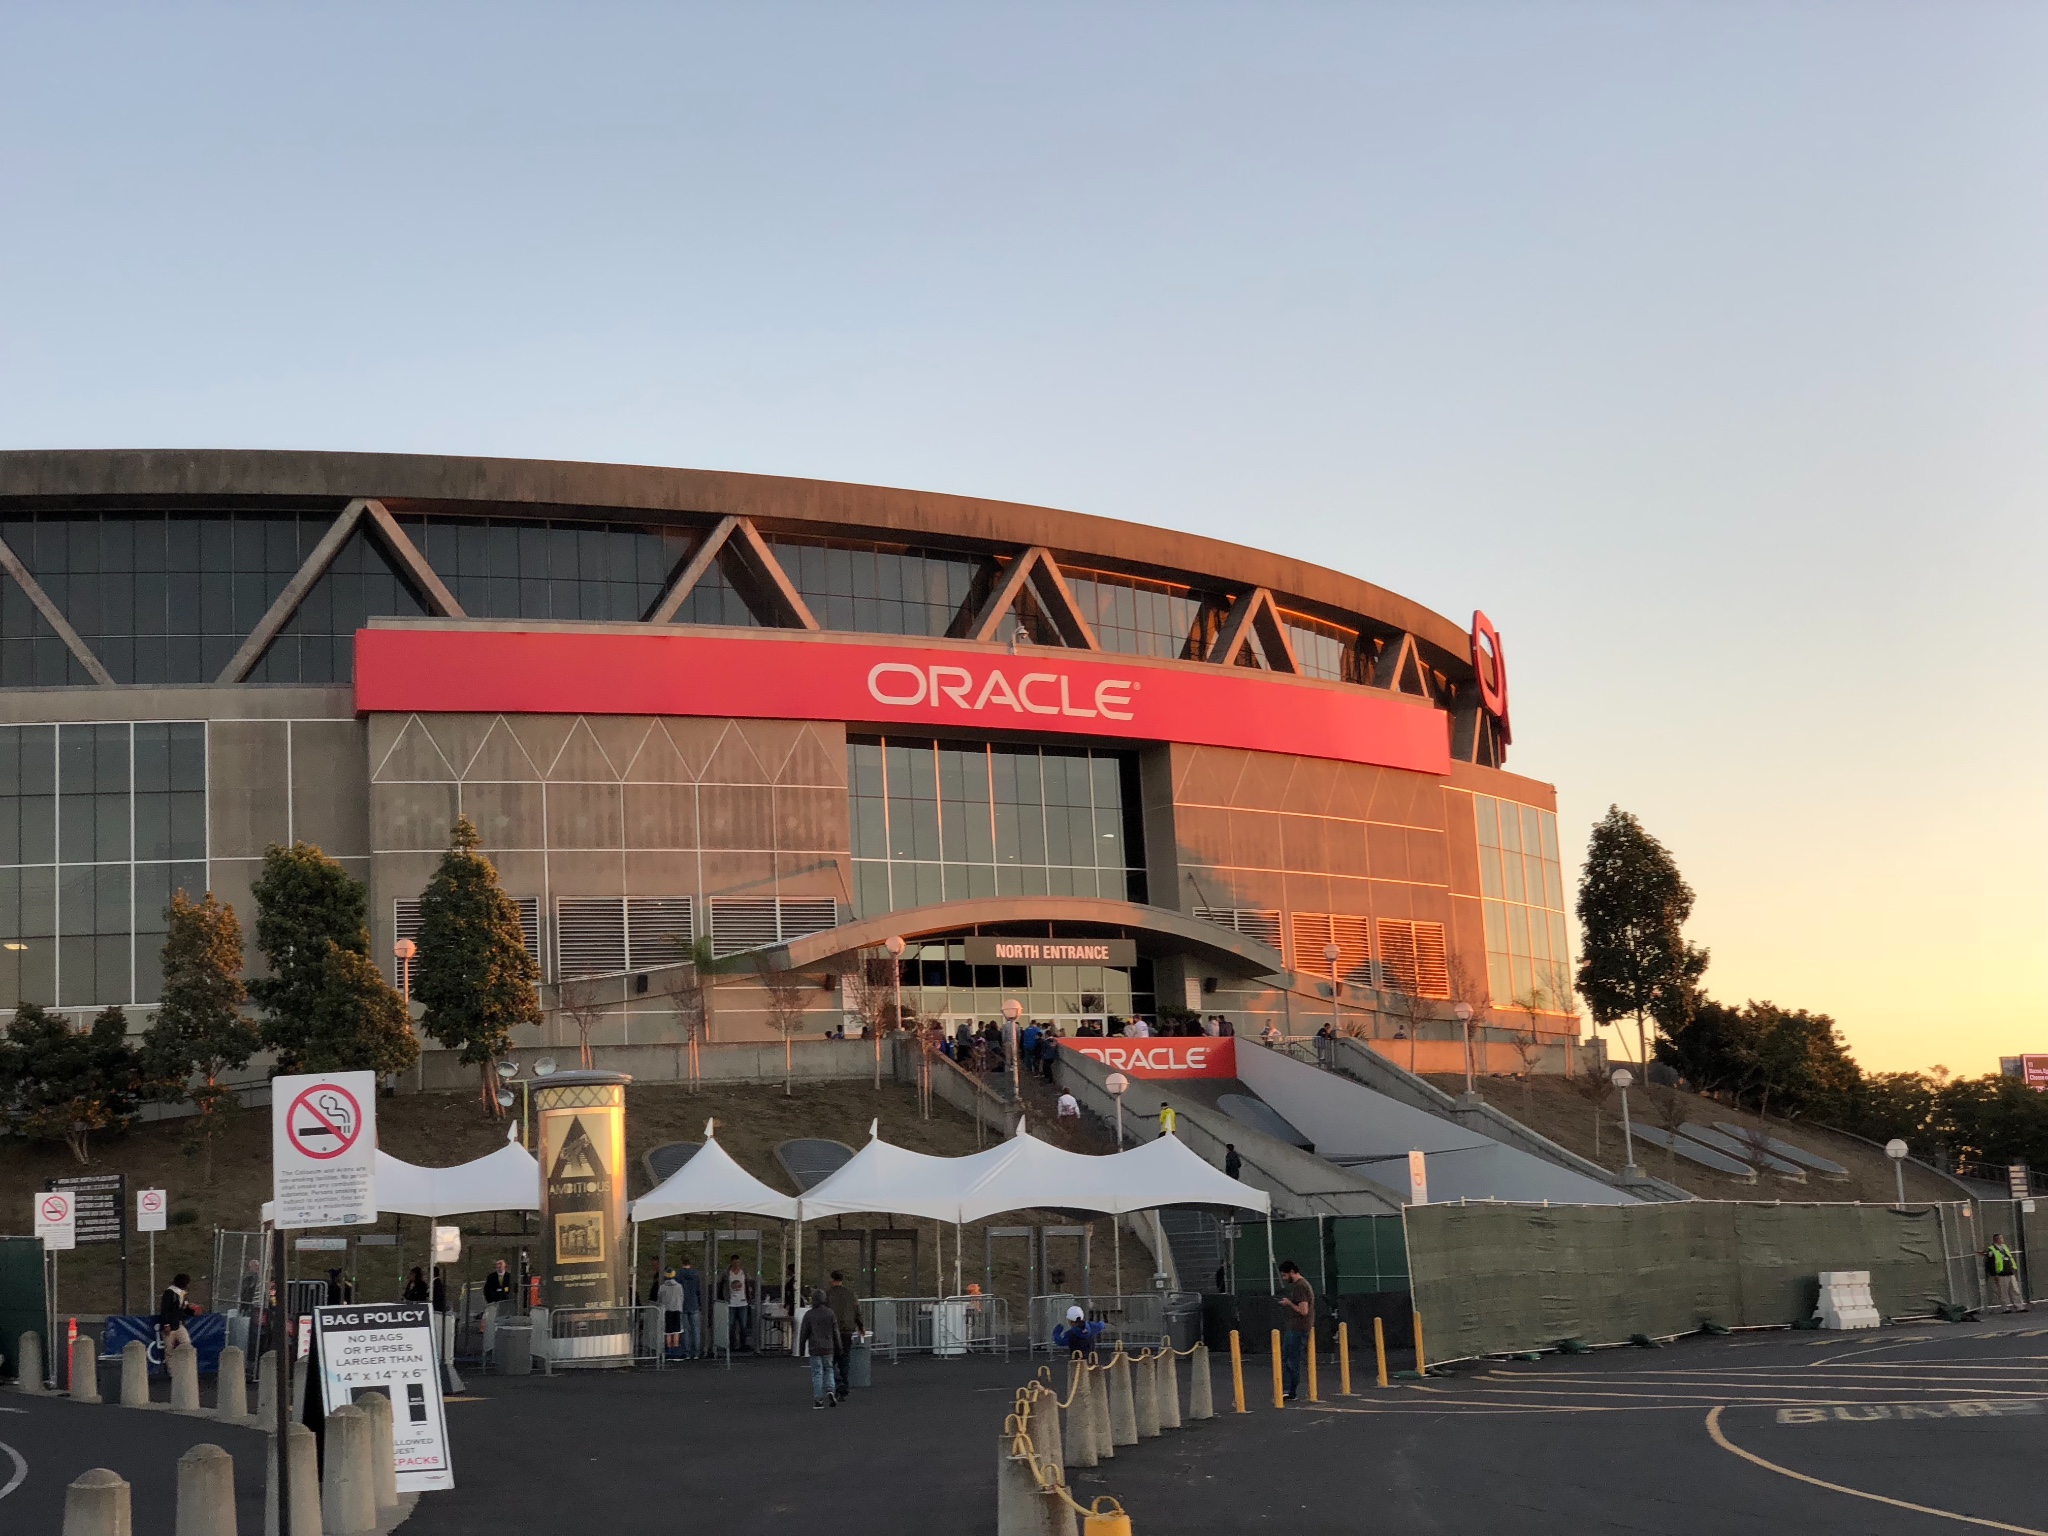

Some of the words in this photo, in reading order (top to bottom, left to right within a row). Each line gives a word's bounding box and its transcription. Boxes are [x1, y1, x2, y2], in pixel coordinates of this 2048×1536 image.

[868, 662, 1135, 721] ORACLE
[996, 943, 1039, 959] NORTH
[1042, 945, 1109, 960] ENTRANCE
[550, 1181, 610, 1194] AMBITIOUS
[322, 1314, 359, 1326] BAG
[364, 1310, 425, 1324] POLICY
[348, 1334, 366, 1343] NO
[370, 1333, 404, 1342] BAGS
[343, 1346, 361, 1354] OR
[364, 1344, 414, 1353] PURSES
[336, 1356, 386, 1366] LARGER
[389, 1354, 423, 1364] THAN
[394, 1438, 434, 1446] LLOWED
